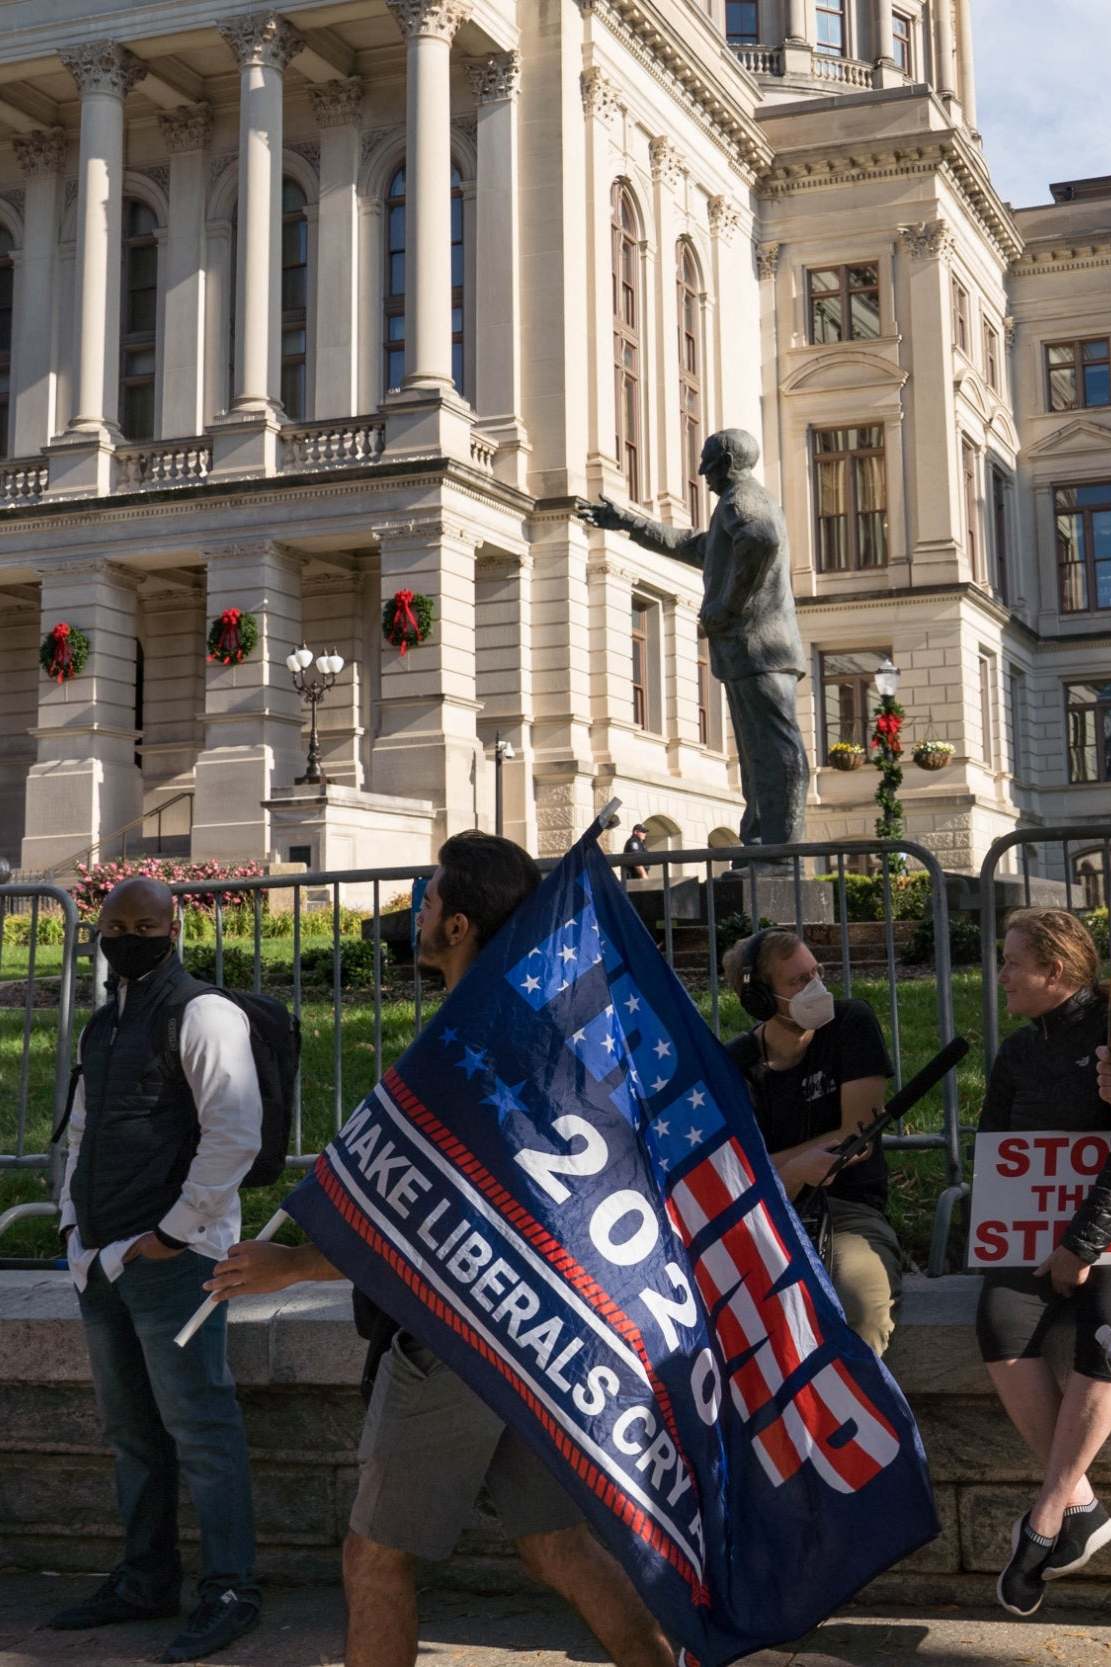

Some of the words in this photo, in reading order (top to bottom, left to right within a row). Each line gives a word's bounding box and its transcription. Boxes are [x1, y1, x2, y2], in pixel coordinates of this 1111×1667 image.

[995, 1136, 1111, 1177] STO
[1031, 1184, 1097, 1212] TH
[338, 1099, 433, 1220] MAKE
[416, 1198, 621, 1416] LIBERALS
[612, 1405, 692, 1508] CRY
[514, 1114, 723, 1427] 2020
